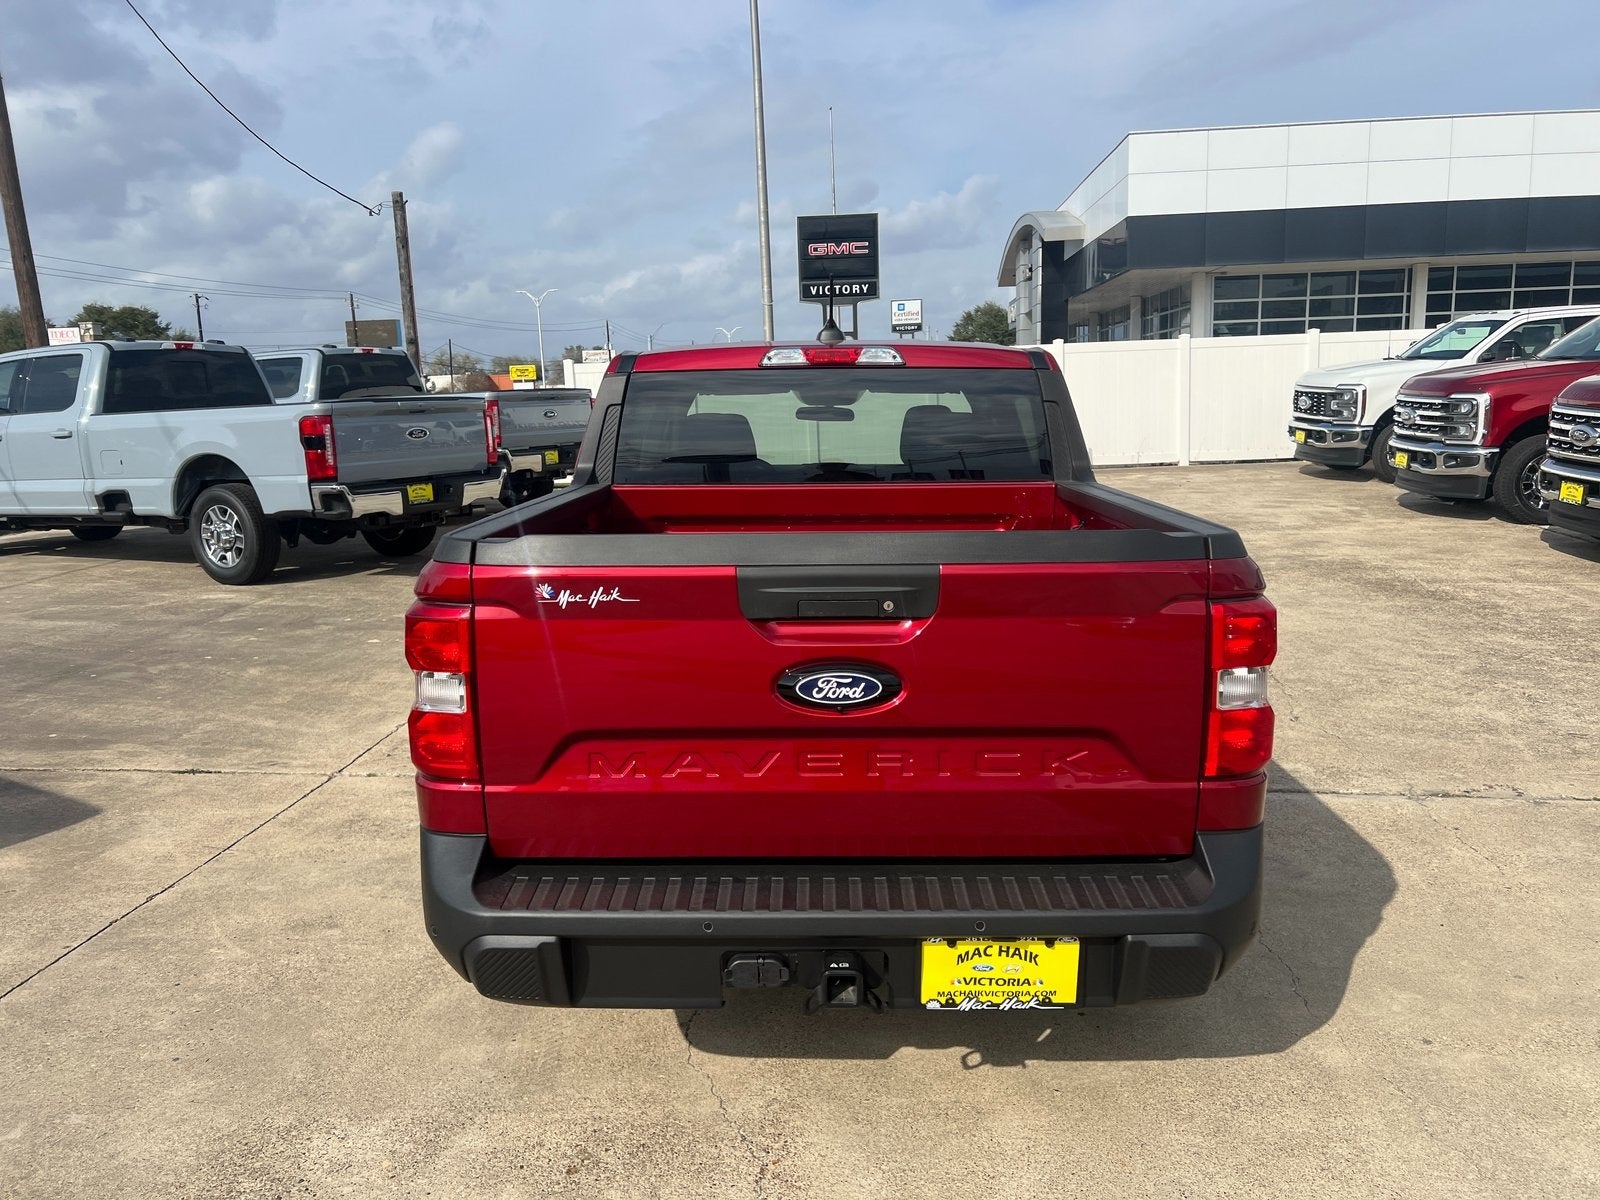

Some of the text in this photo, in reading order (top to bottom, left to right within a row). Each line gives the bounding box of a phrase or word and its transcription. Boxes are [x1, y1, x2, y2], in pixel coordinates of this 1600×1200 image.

[808, 241, 869, 256] GMC
[810, 284, 869, 295] VICTORY
[557, 586, 625, 609] Mac Haik
[811, 676, 866, 700] Ford
[588, 751, 1089, 779] MAVERICK
[956, 945, 1040, 966] MAC HAIK
[962, 977, 1032, 986] VICTORIA
[936, 990, 1057, 998] MACHAIKVICTORIA.COM
[958, 996, 1041, 1011] Mac Haik
